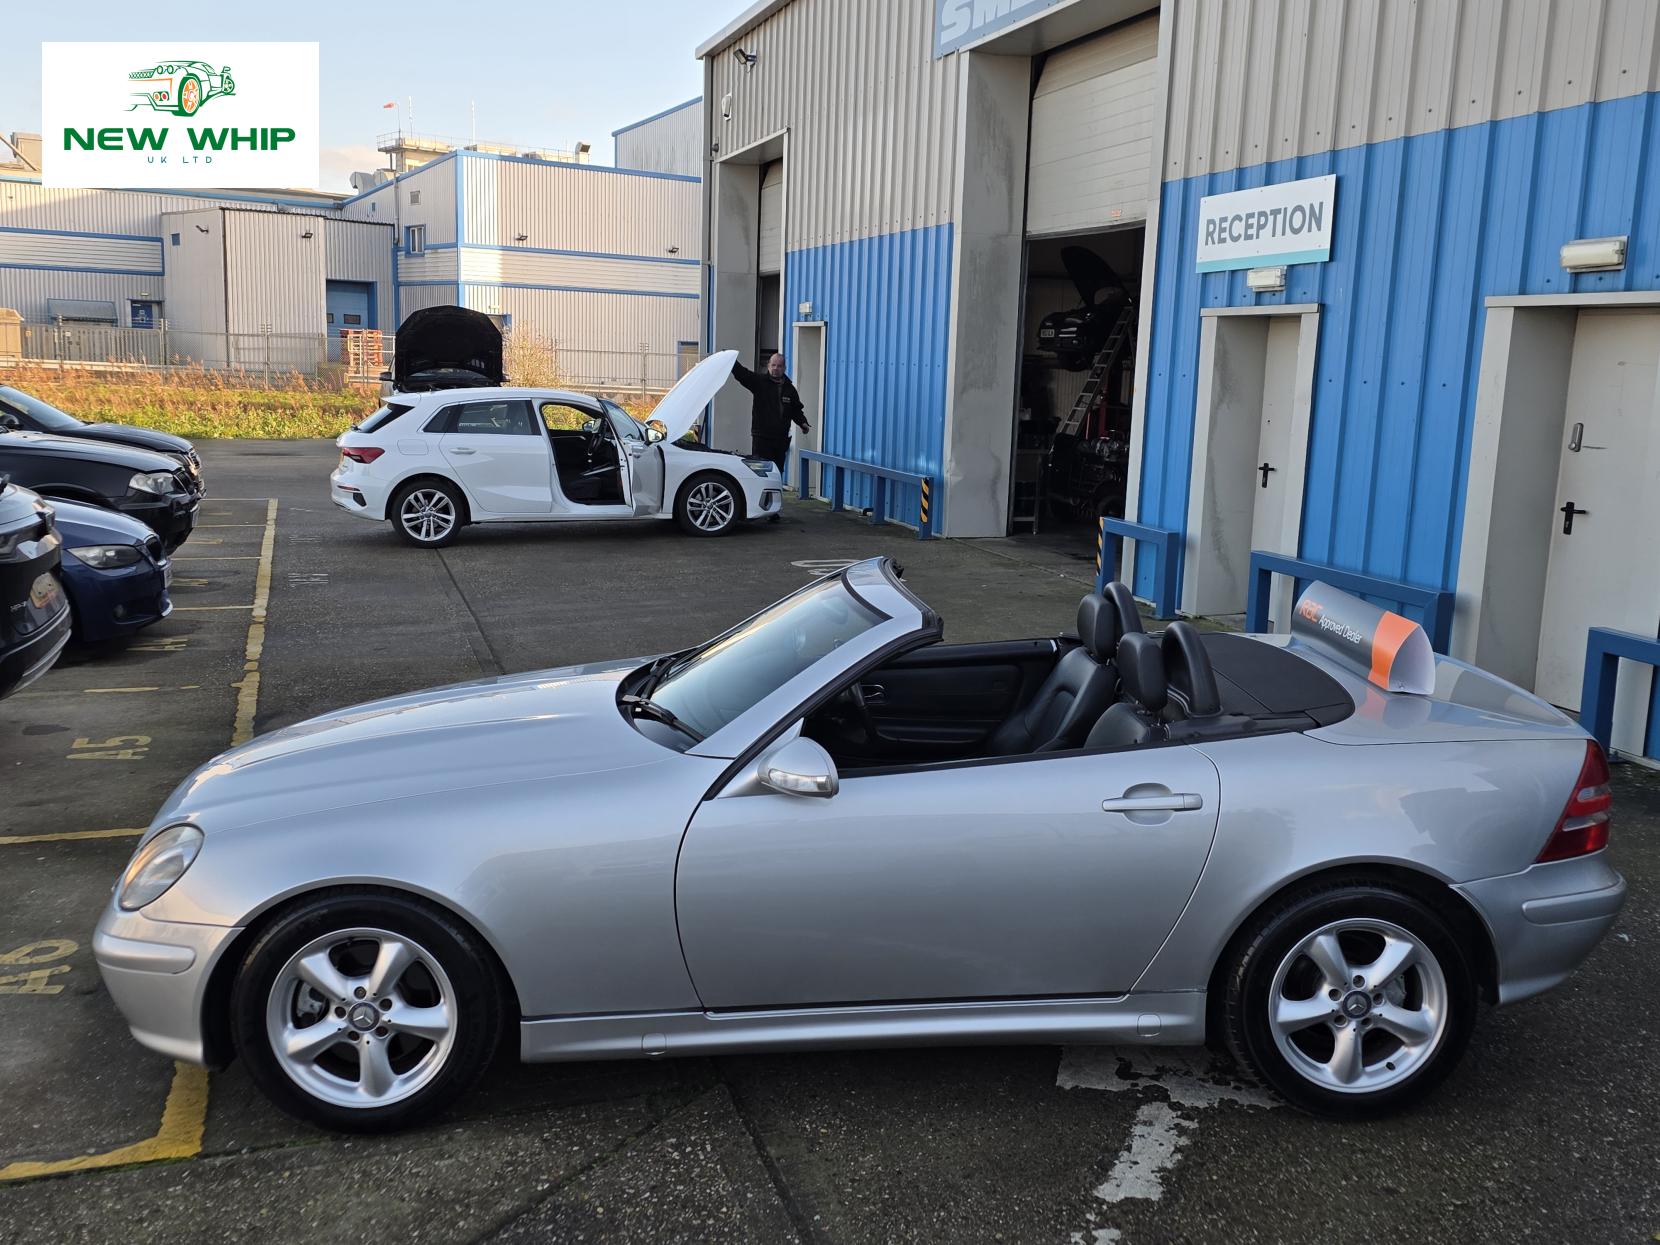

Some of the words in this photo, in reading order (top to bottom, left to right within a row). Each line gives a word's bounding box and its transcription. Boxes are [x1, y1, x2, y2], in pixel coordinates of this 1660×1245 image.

[1204, 201, 1324, 246] RECEPTION
[1319, 614, 1345, 635] Approved
[1342, 625, 1363, 644] Dealer
